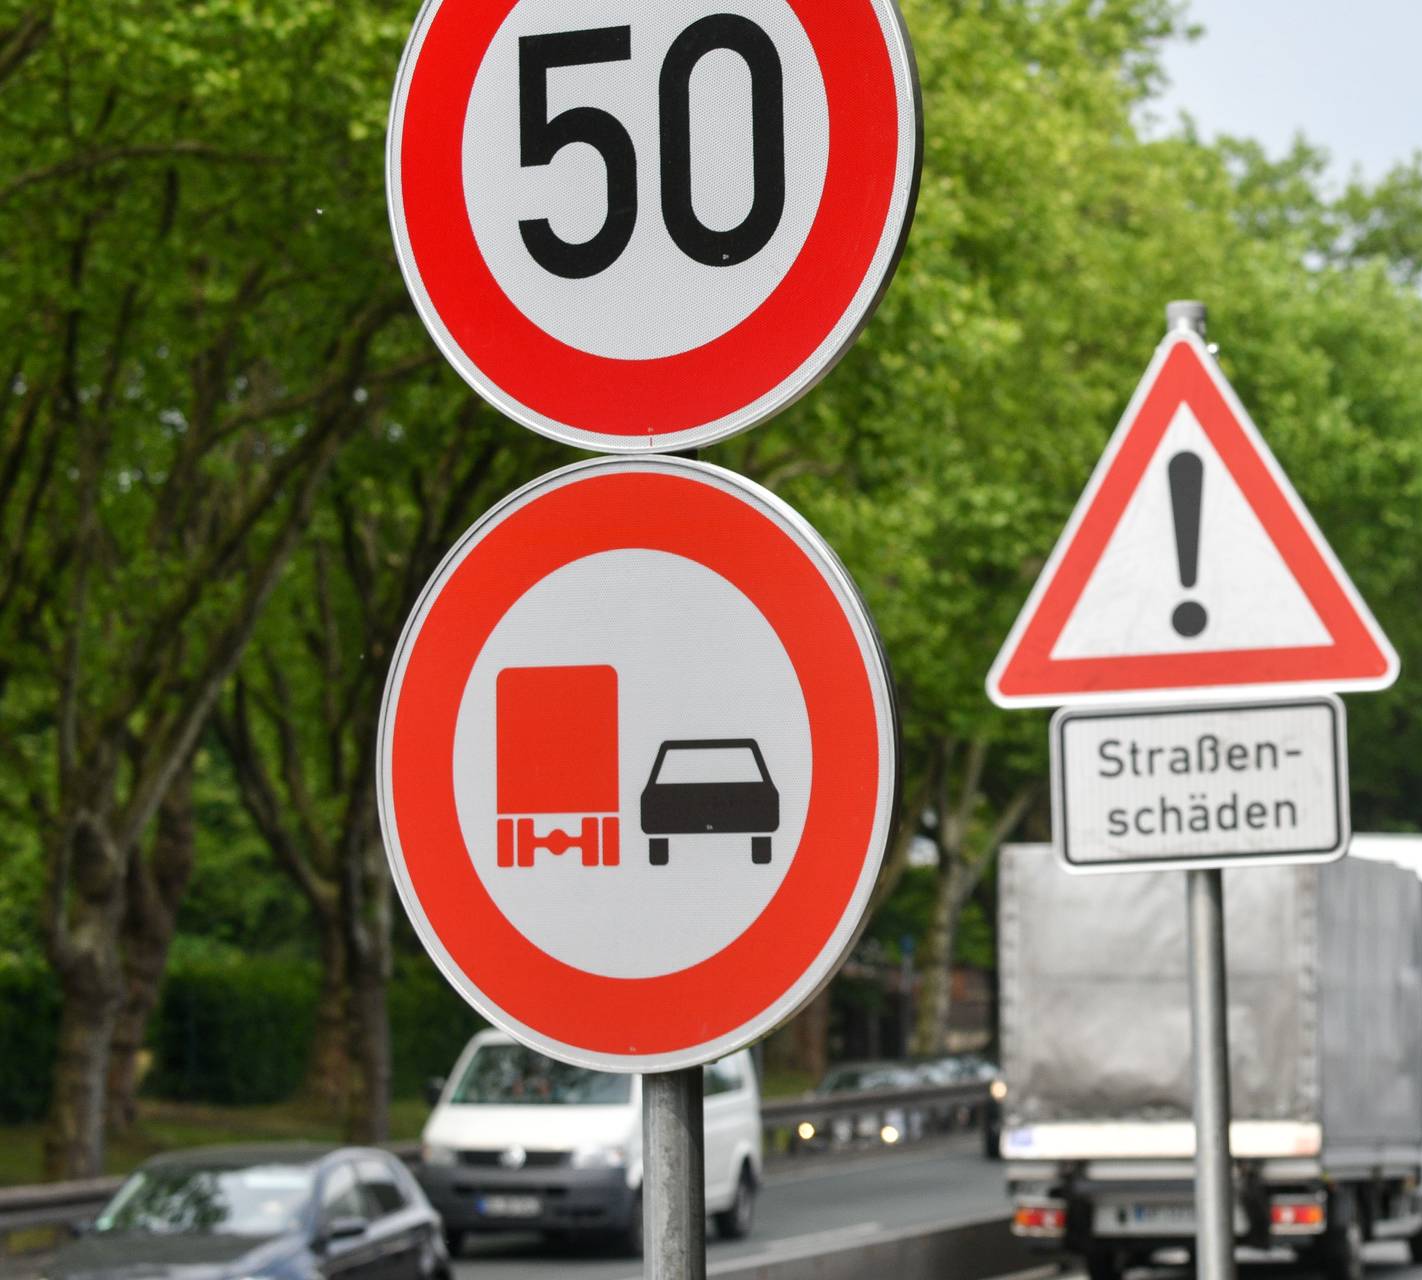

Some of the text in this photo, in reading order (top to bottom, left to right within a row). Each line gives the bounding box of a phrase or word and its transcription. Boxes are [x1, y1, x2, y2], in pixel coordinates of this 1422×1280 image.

[518, 13, 786, 279] 50
[1098, 733, 1303, 779] Straßen-
[1107, 793, 1298, 837] schäden
